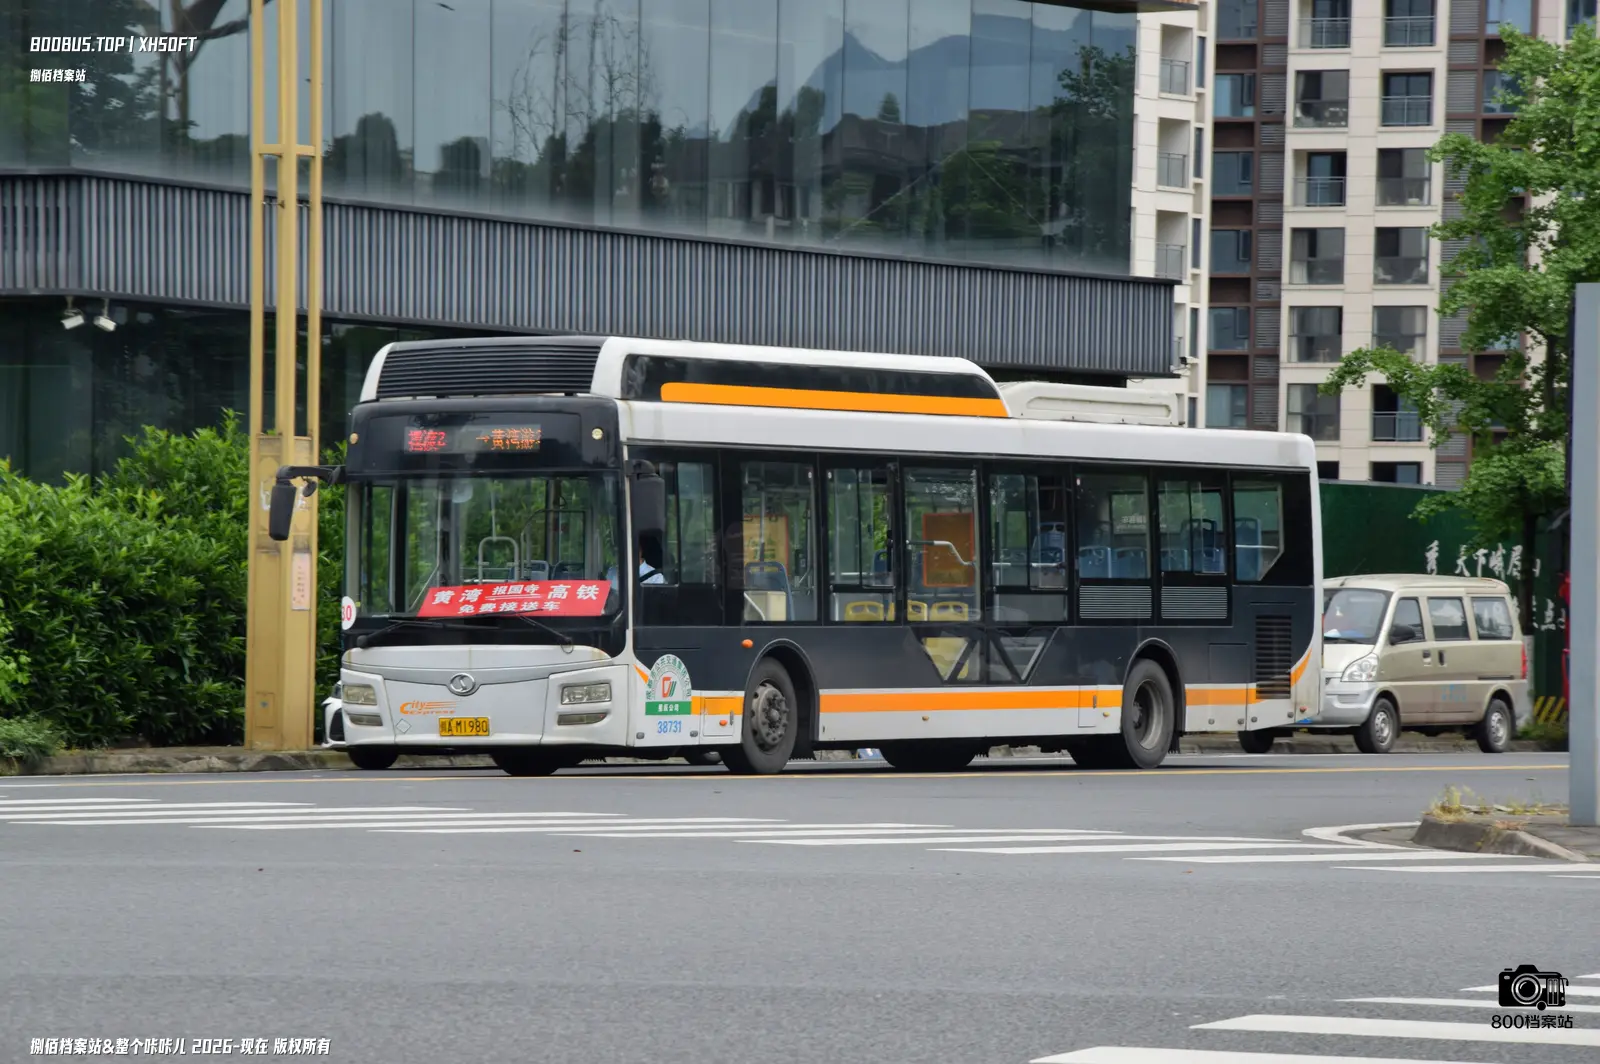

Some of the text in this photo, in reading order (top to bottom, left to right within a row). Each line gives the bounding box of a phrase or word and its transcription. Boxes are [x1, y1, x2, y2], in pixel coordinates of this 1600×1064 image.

[432, 584, 600, 605] 黄湾 报国寺 高铁
[457, 601, 560, 614] 免费接送车
[657, 720, 682, 733] 38731
